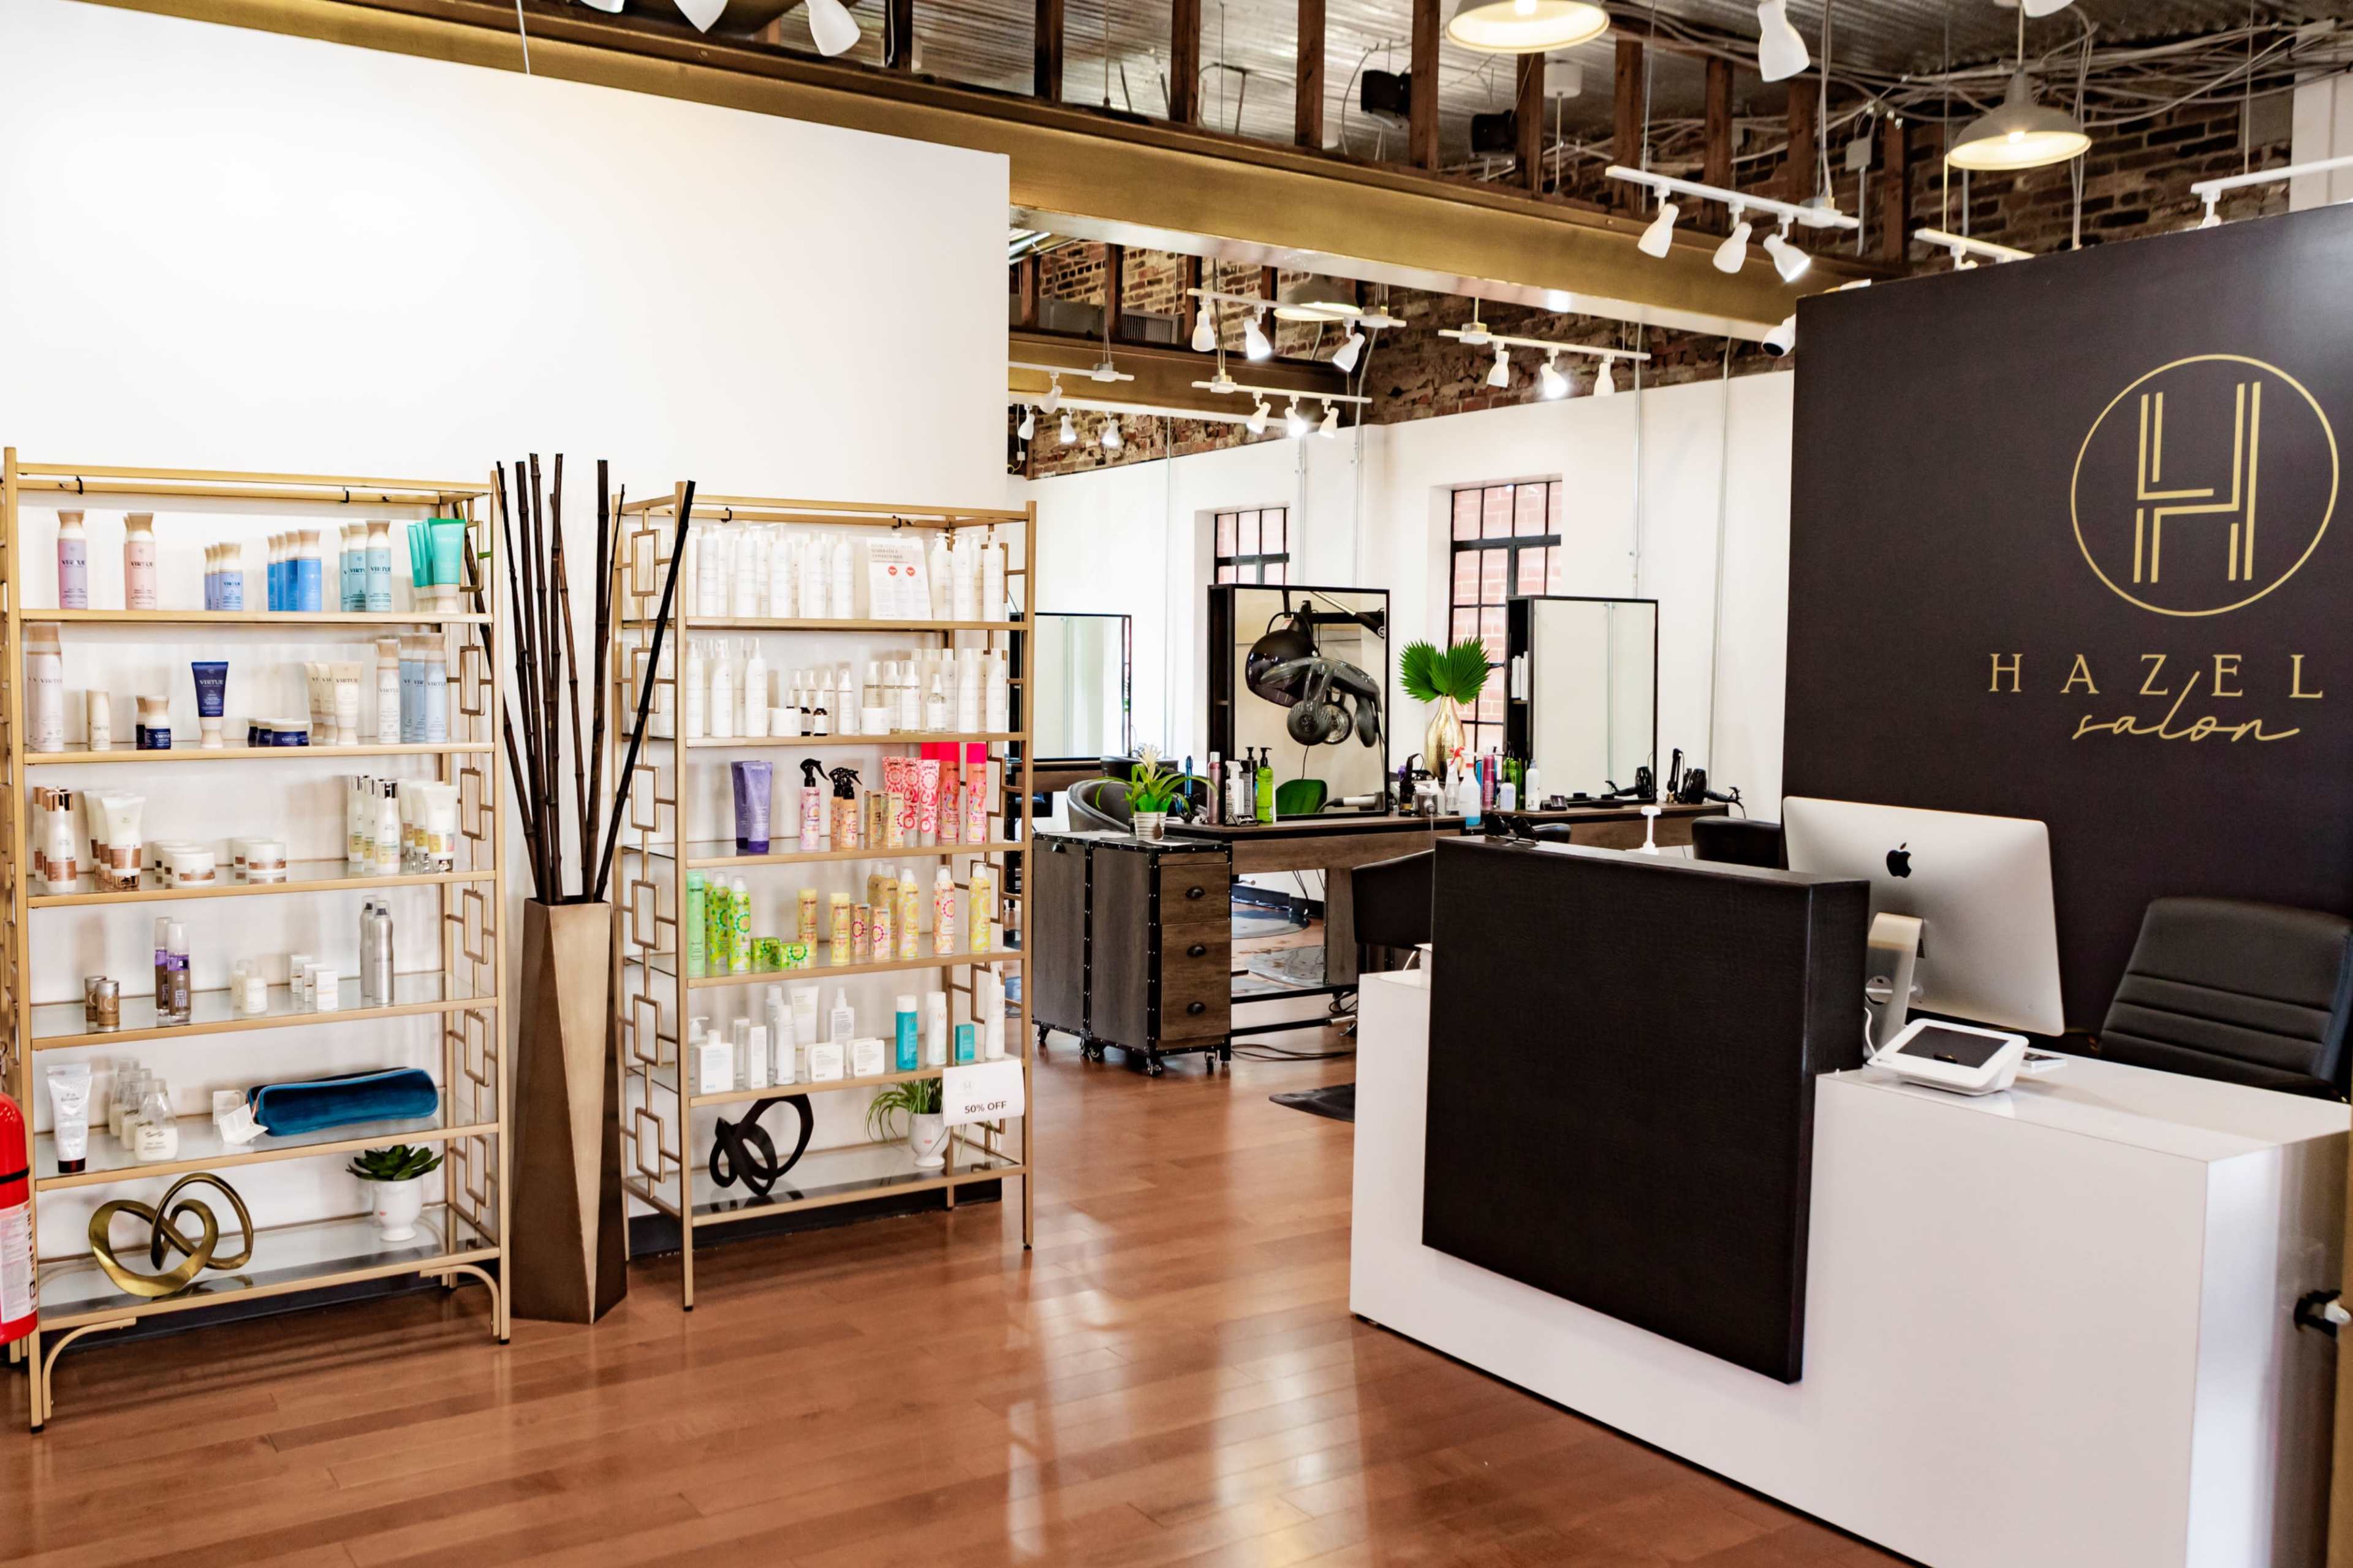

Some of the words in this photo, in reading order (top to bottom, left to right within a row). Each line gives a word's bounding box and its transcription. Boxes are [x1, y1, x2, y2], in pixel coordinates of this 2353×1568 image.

[1988, 653, 2324, 699] HAZEL
[2072, 670, 2300, 743] salon
[964, 1103, 985, 1114] 50%
[987, 1100, 1007, 1111] OFF
